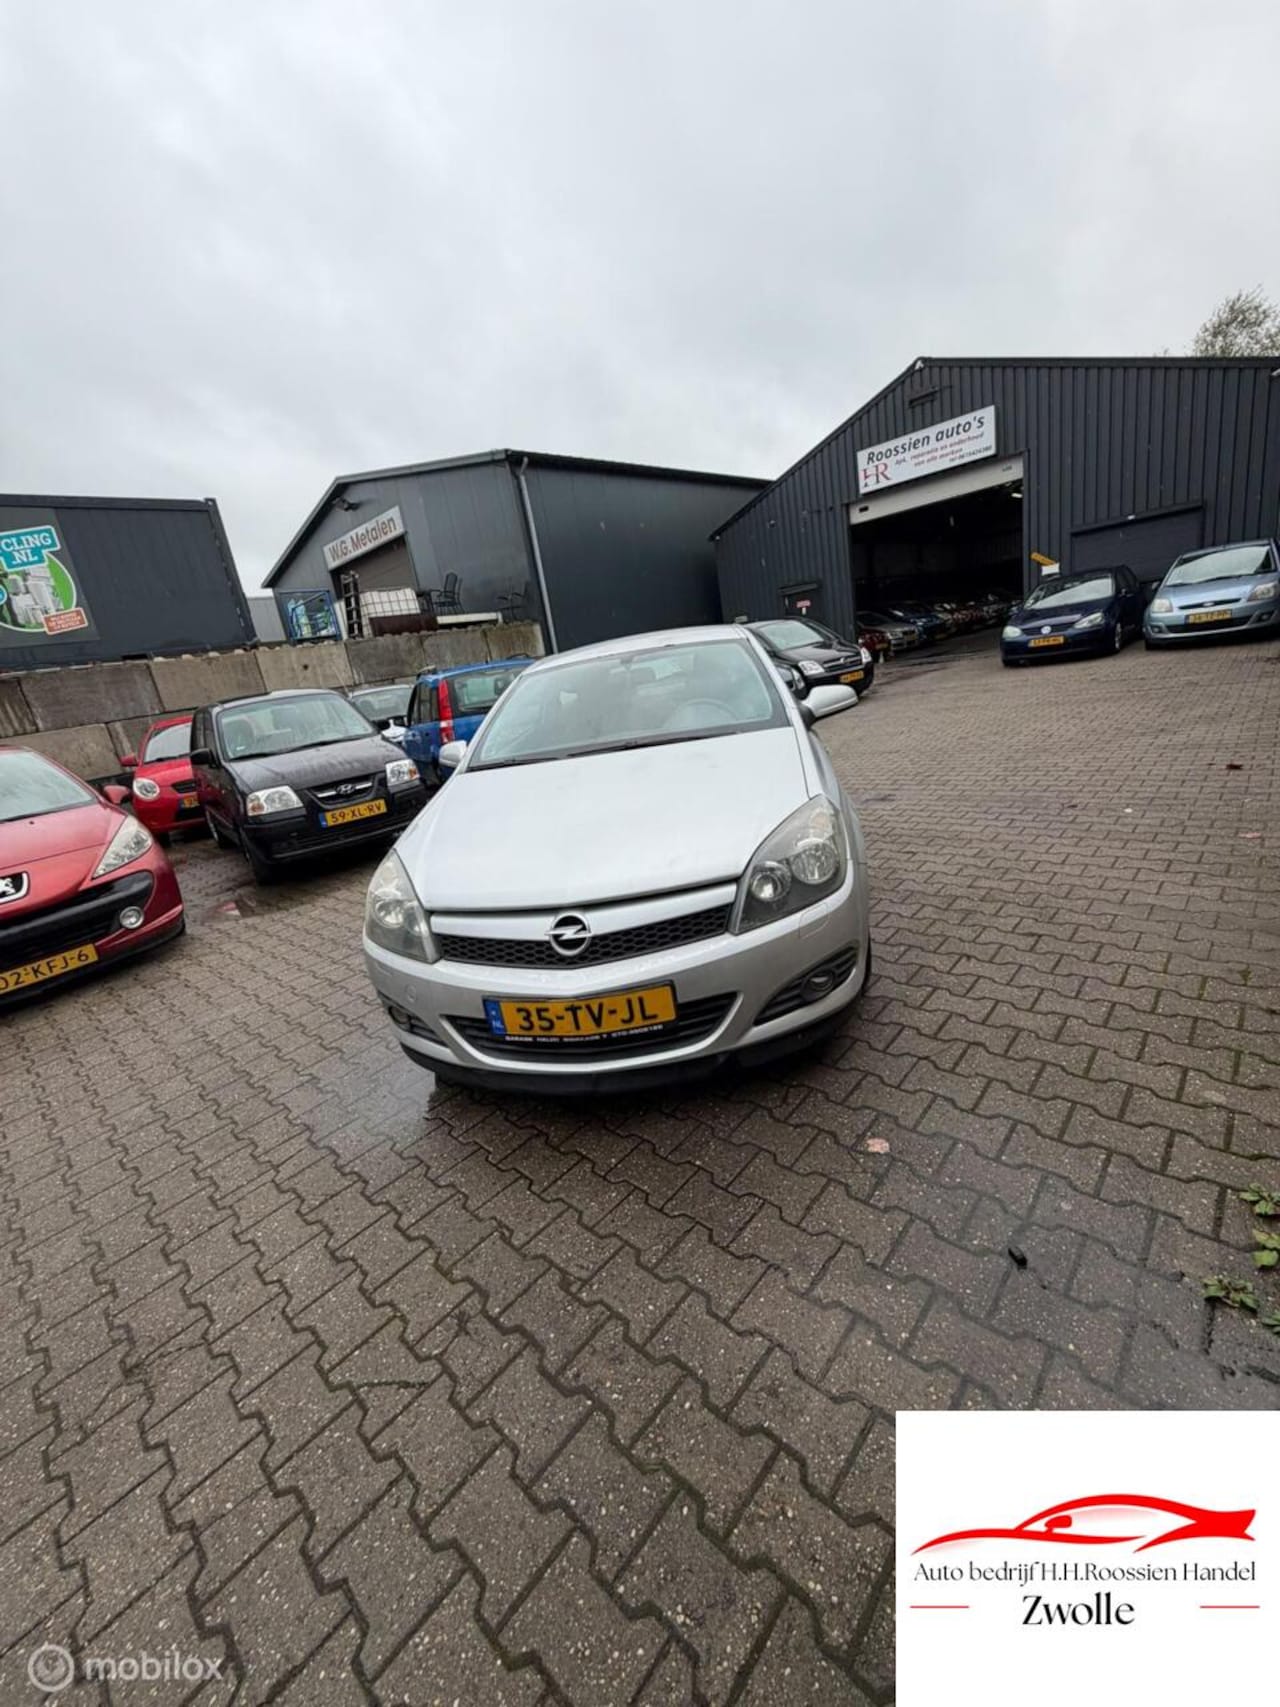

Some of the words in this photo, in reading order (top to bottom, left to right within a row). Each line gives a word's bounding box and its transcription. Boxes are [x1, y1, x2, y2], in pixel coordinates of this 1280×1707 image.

[866, 435, 931, 465] Roossien
[935, 416, 985, 442] auto's
[0, 533, 51, 552] CLING
[516, 996, 658, 1032] 35-TV-JL
